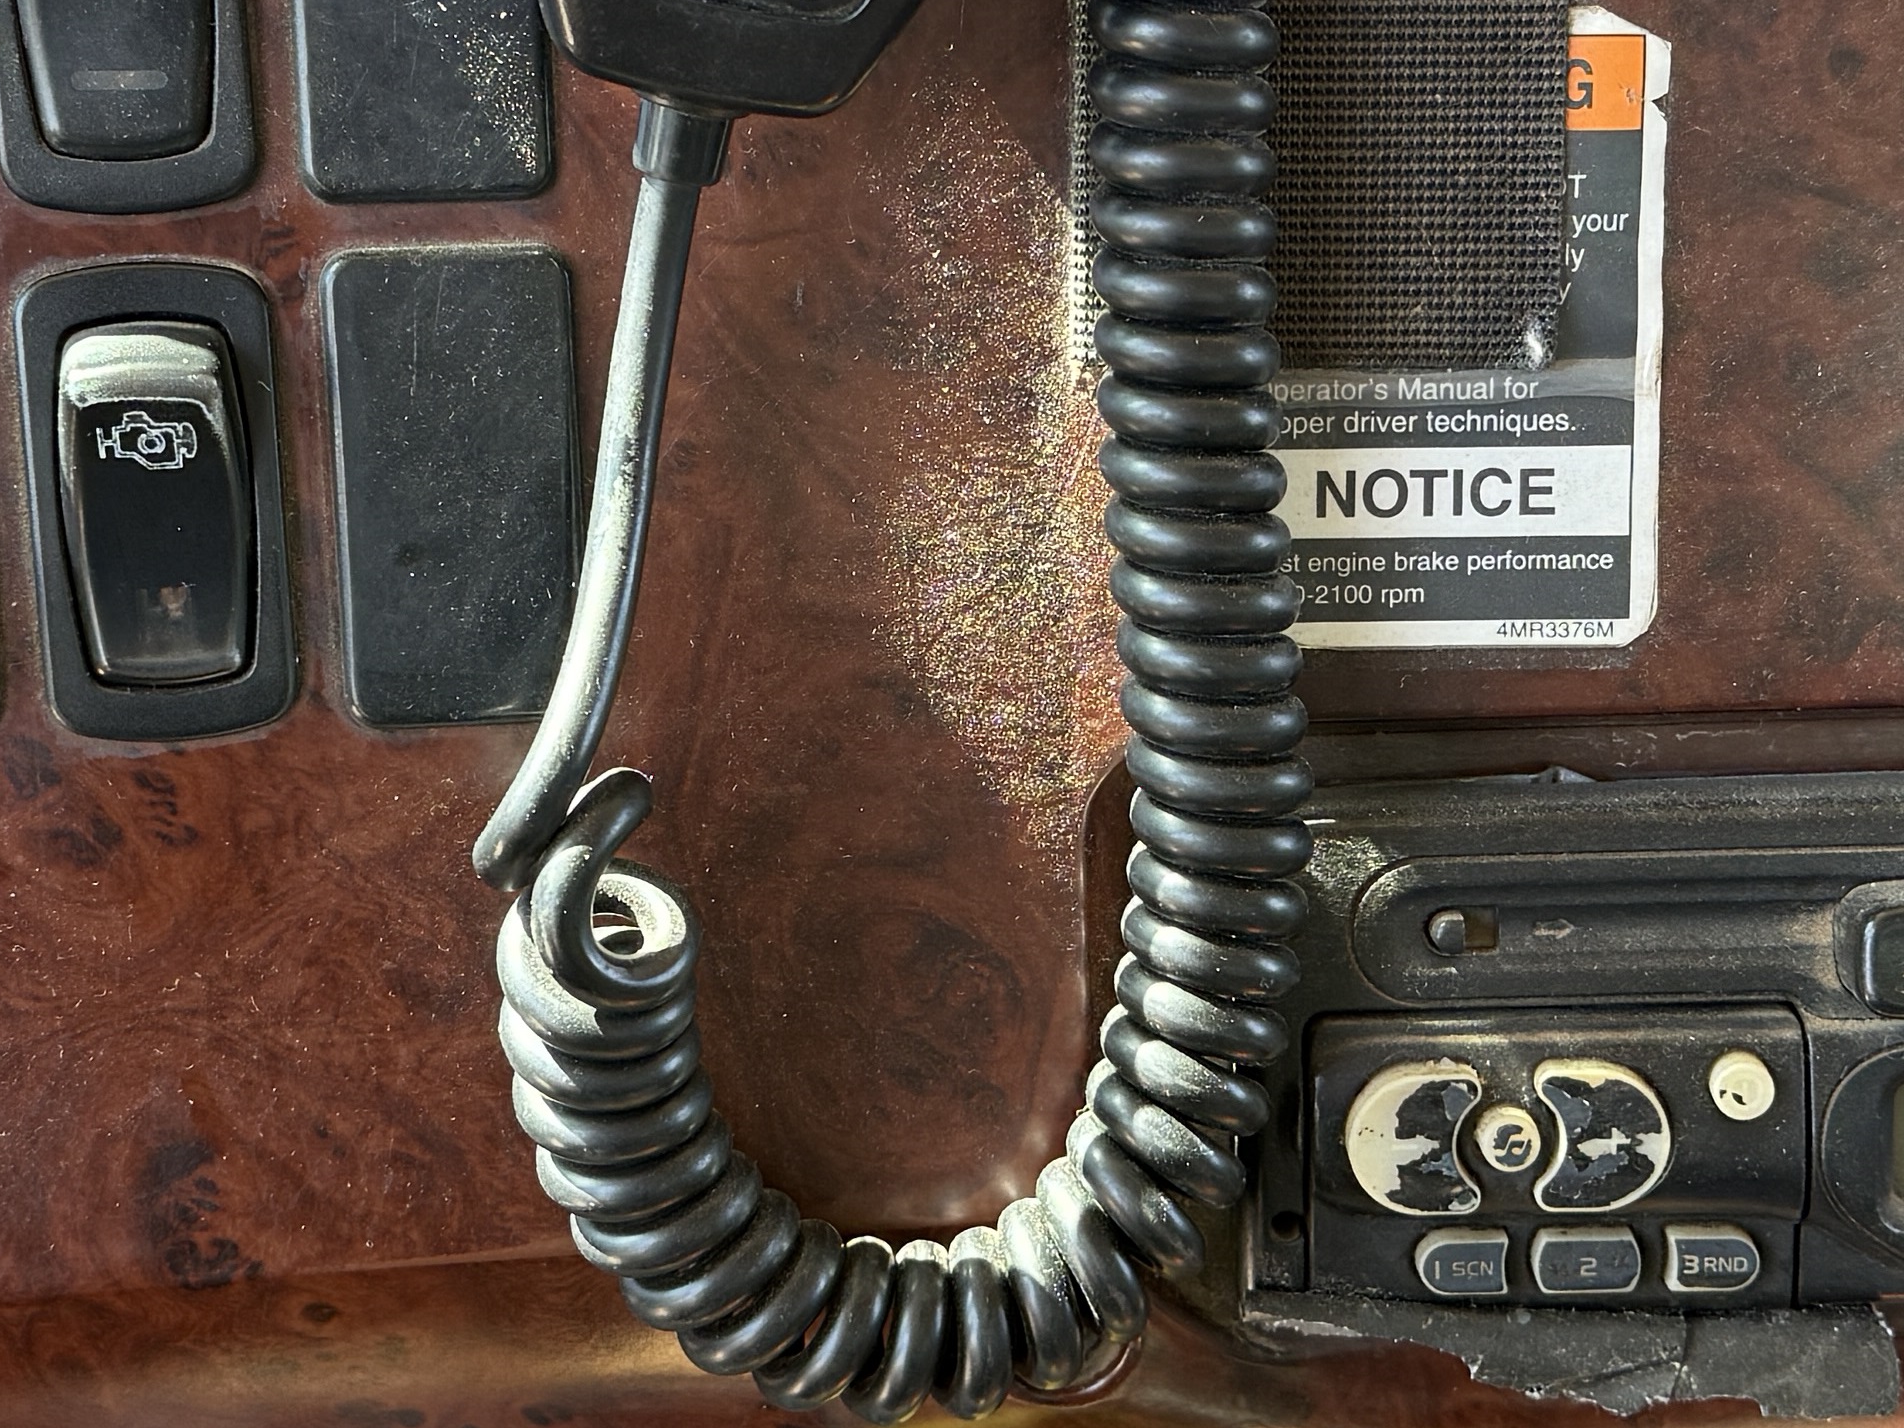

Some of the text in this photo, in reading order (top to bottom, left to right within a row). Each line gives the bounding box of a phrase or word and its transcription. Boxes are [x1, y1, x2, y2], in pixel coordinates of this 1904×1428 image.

[1572, 213, 1629, 238] your
[1268, 376, 1539, 402] perator's Manual for
[1343, 410, 1418, 433] driver
[1426, 410, 1575, 437] techniques.
[1315, 468, 1556, 519] NOTICE
[1308, 552, 1386, 577] engine
[1394, 551, 1460, 572] brake
[1466, 549, 1614, 577] performance
[1381, 586, 1425, 608] rpm
[1496, 621, 1614, 639] 4MR3376M
[1579, 1257, 1598, 1276] 2
[1682, 1254, 1749, 1274] 3 RND
